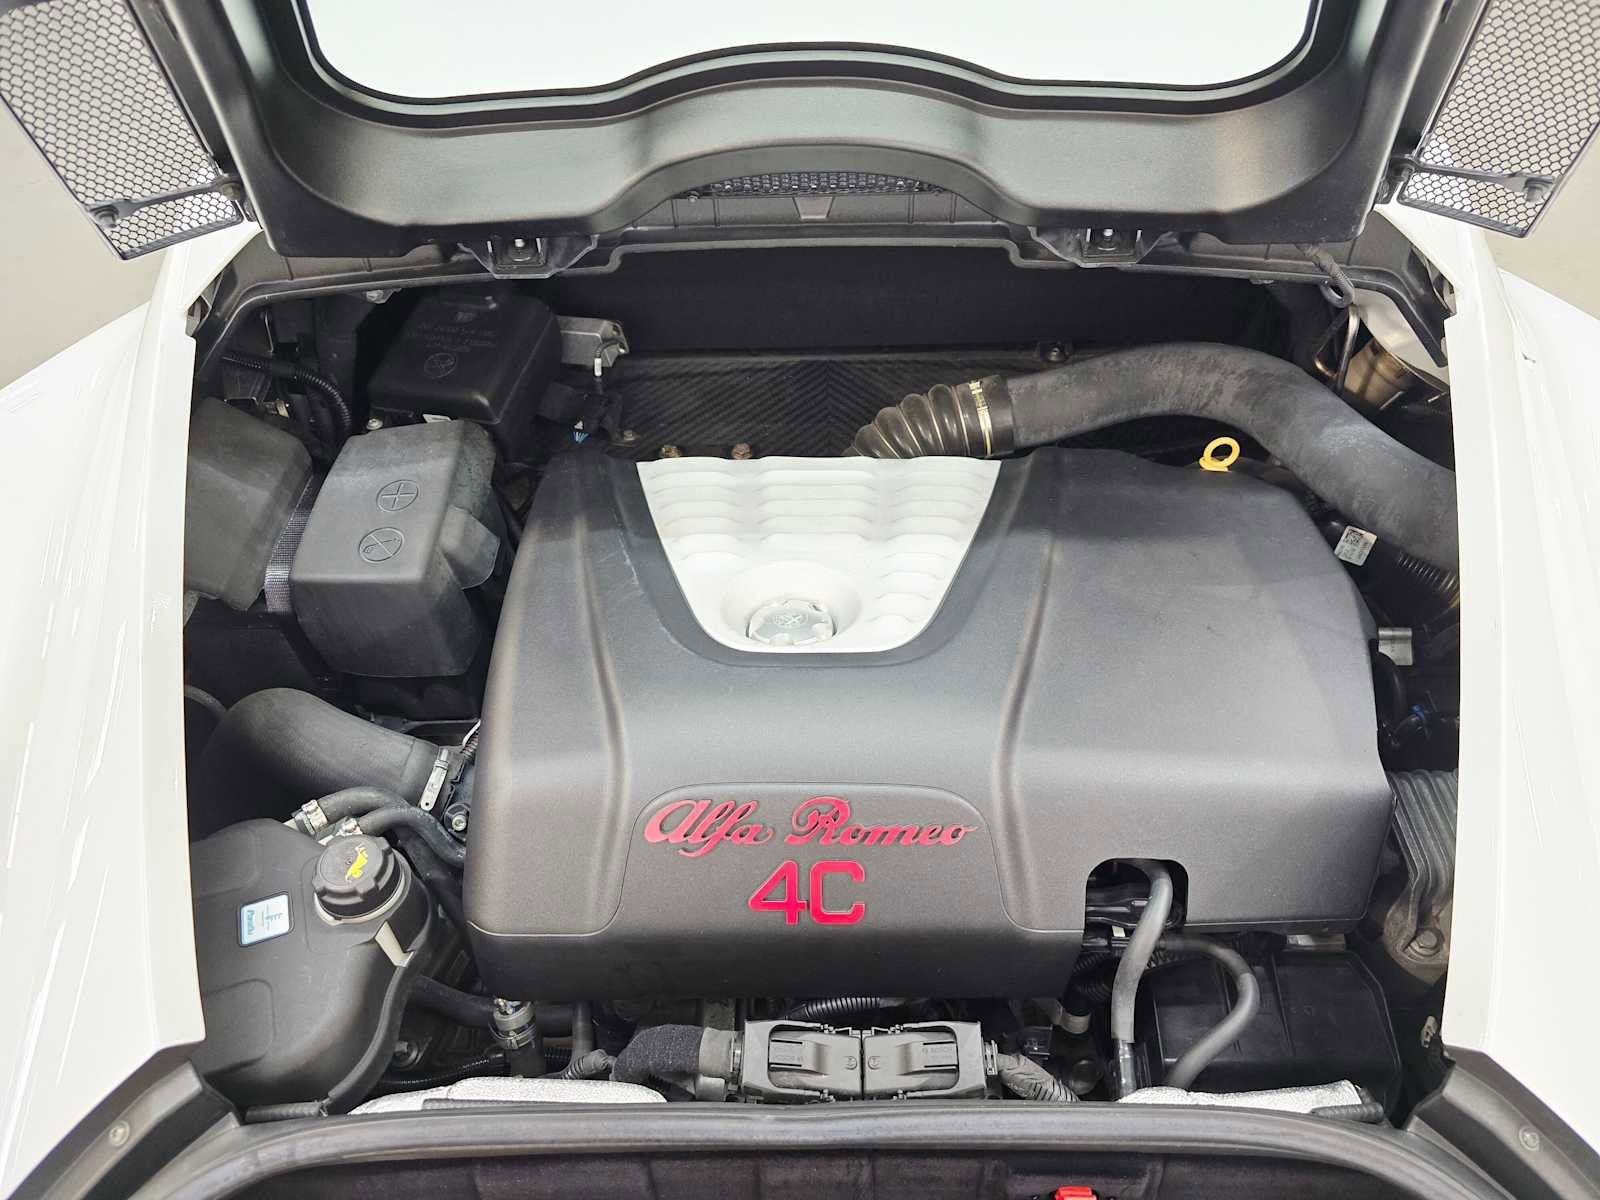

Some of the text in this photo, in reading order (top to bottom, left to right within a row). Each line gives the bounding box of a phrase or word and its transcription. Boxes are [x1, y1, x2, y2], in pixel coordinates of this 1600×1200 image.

[643, 796, 979, 858] Alfa Romeo
[747, 859, 866, 927] 4C
